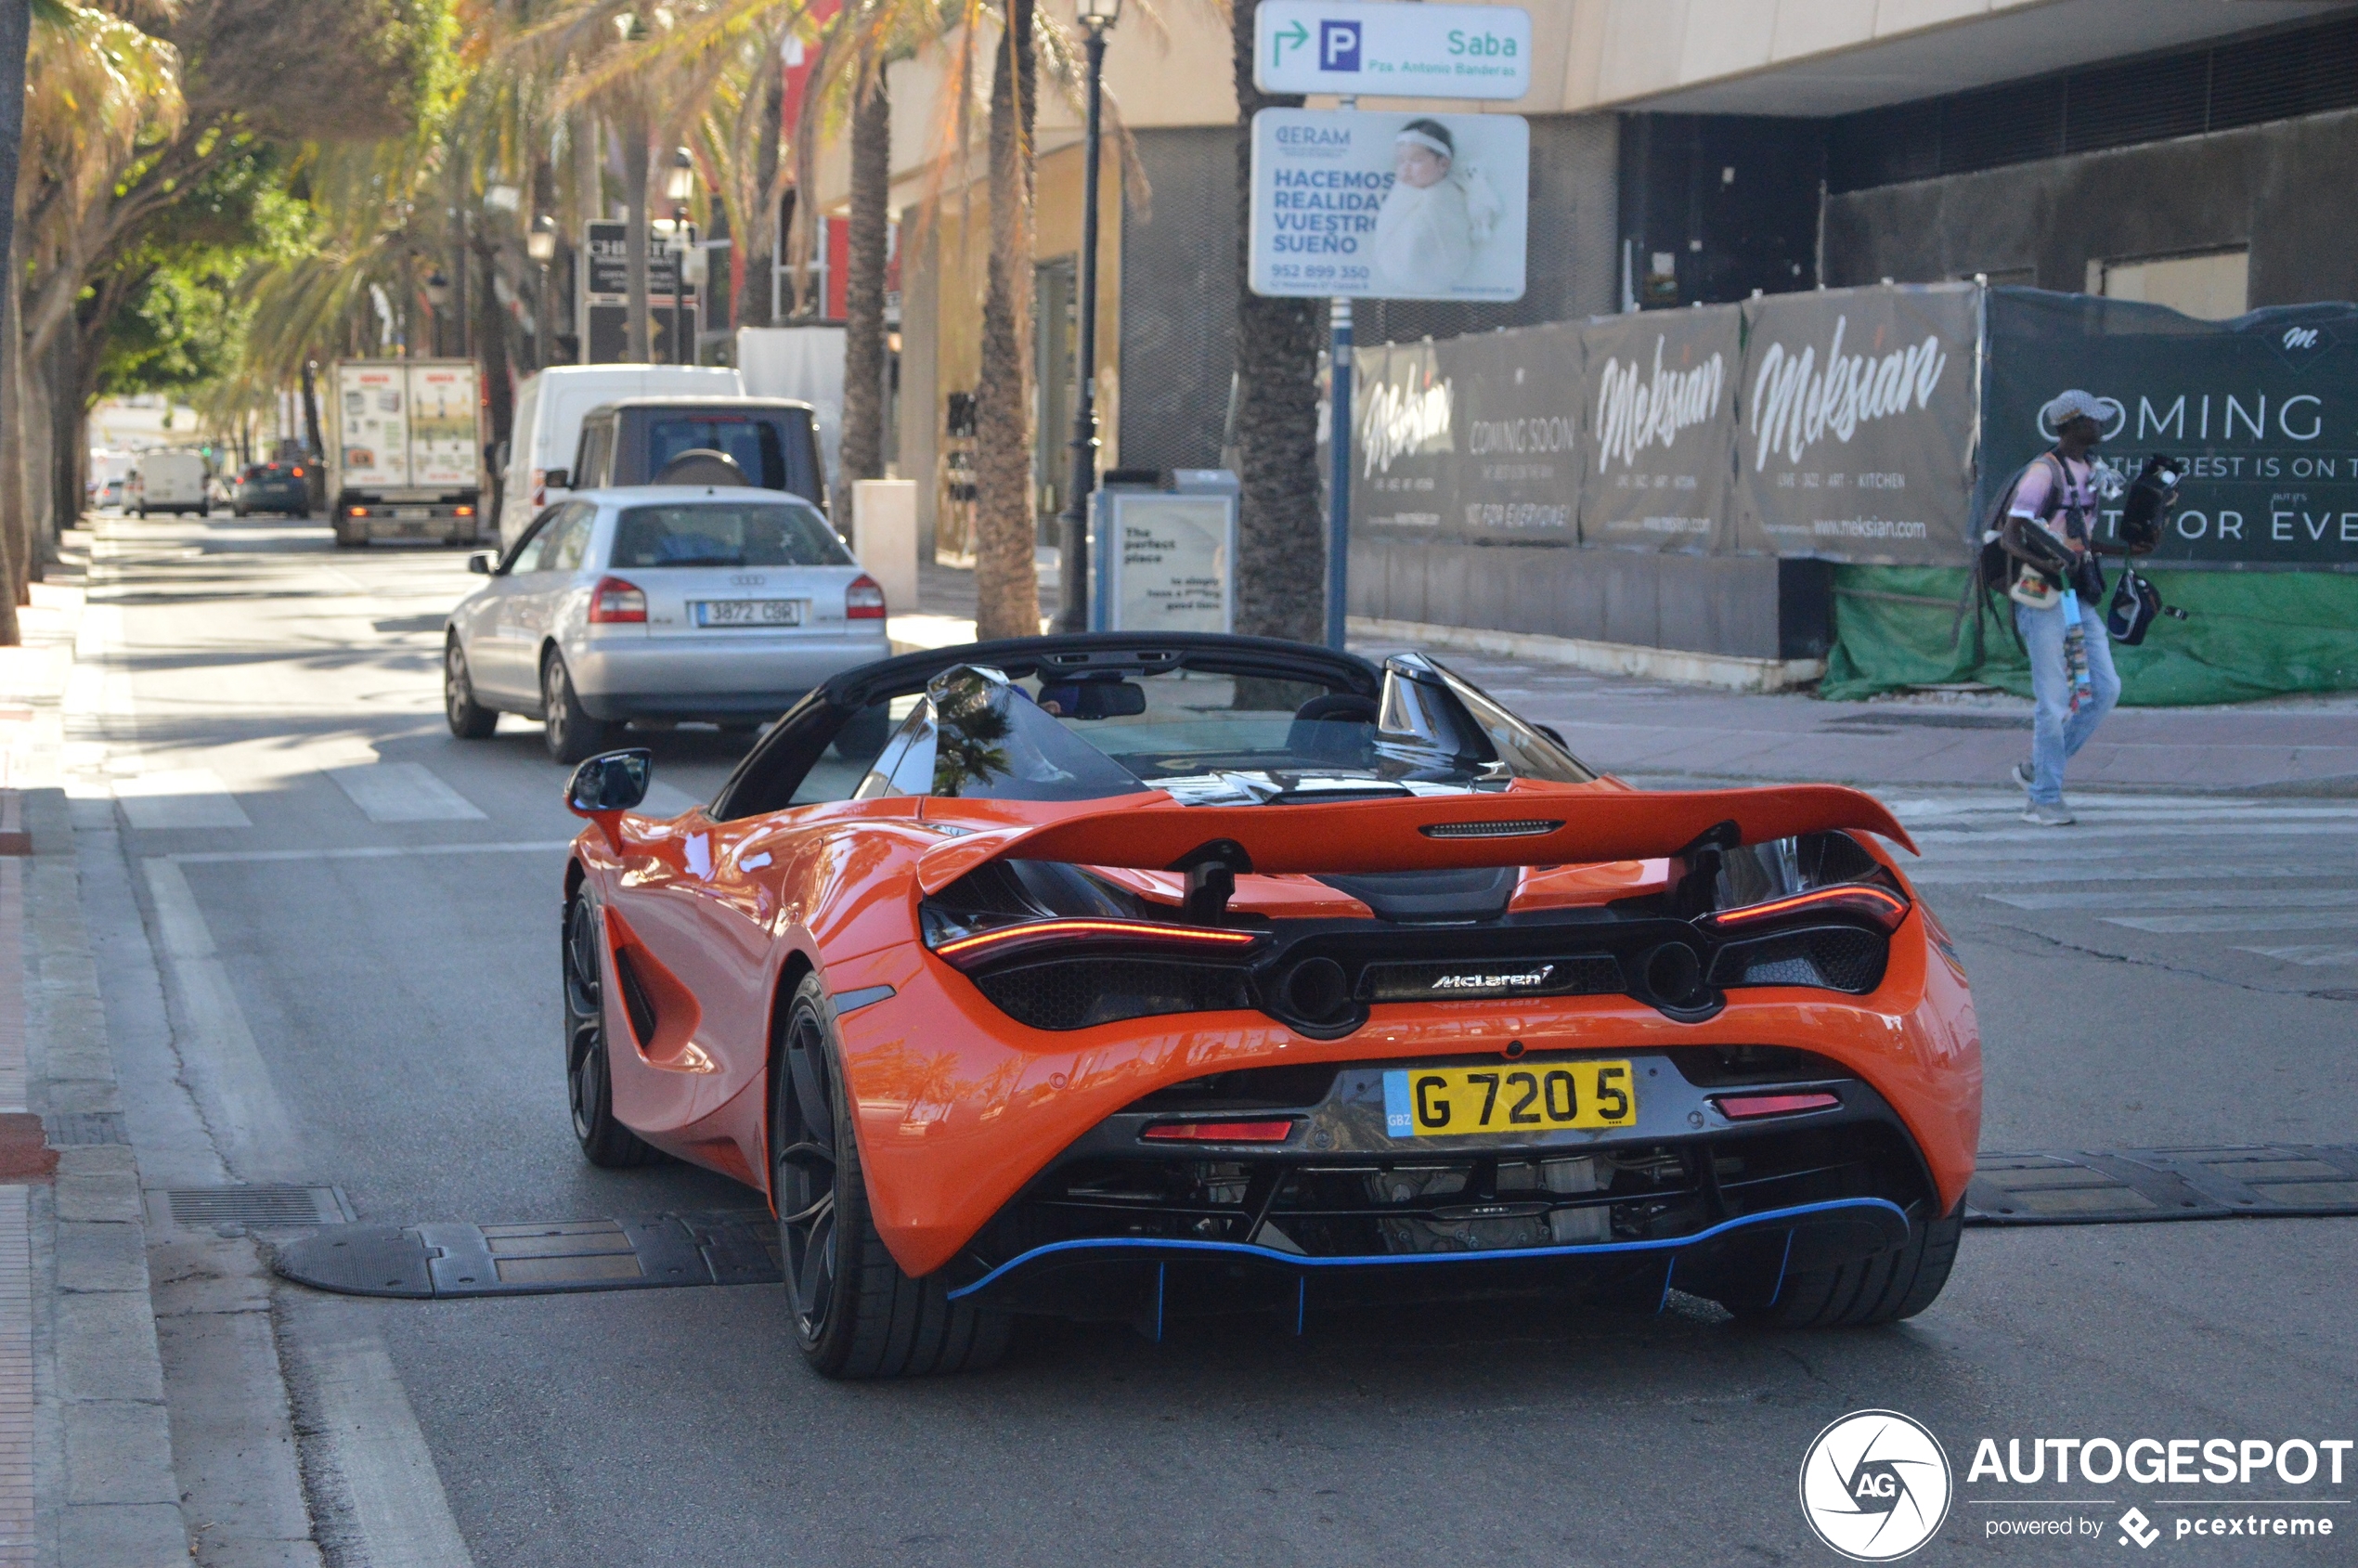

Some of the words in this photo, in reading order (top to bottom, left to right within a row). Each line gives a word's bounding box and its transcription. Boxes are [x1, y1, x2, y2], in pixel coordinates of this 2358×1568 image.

[1326, 26, 1356, 66] P
[1447, 29, 1517, 57] Saba
[1401, 60, 1452, 75] Antonio
[1455, 62, 1517, 77] Banderas
[1274, 168, 1395, 190] HACEMOS
[1274, 190, 1389, 211] REALIDA
[1273, 231, 1357, 254] SUEÑO
[1596, 332, 1725, 474] Meksian
[1751, 314, 1947, 473] Meksian
[1469, 418, 1527, 456] COMING
[1528, 416, 1575, 453] SOON
[2255, 457, 2281, 478] IS
[2291, 458, 2336, 478] ON
[1858, 472, 1906, 490] KITCHEN
[1814, 516, 1927, 538] www.meksian.com
[1432, 966, 1552, 990] McLaren
[1416, 1075, 1451, 1129] G
[1466, 1069, 1579, 1126] 720
[1595, 1068, 1629, 1120] 5
[1387, 1113, 1413, 1127] GBZ
